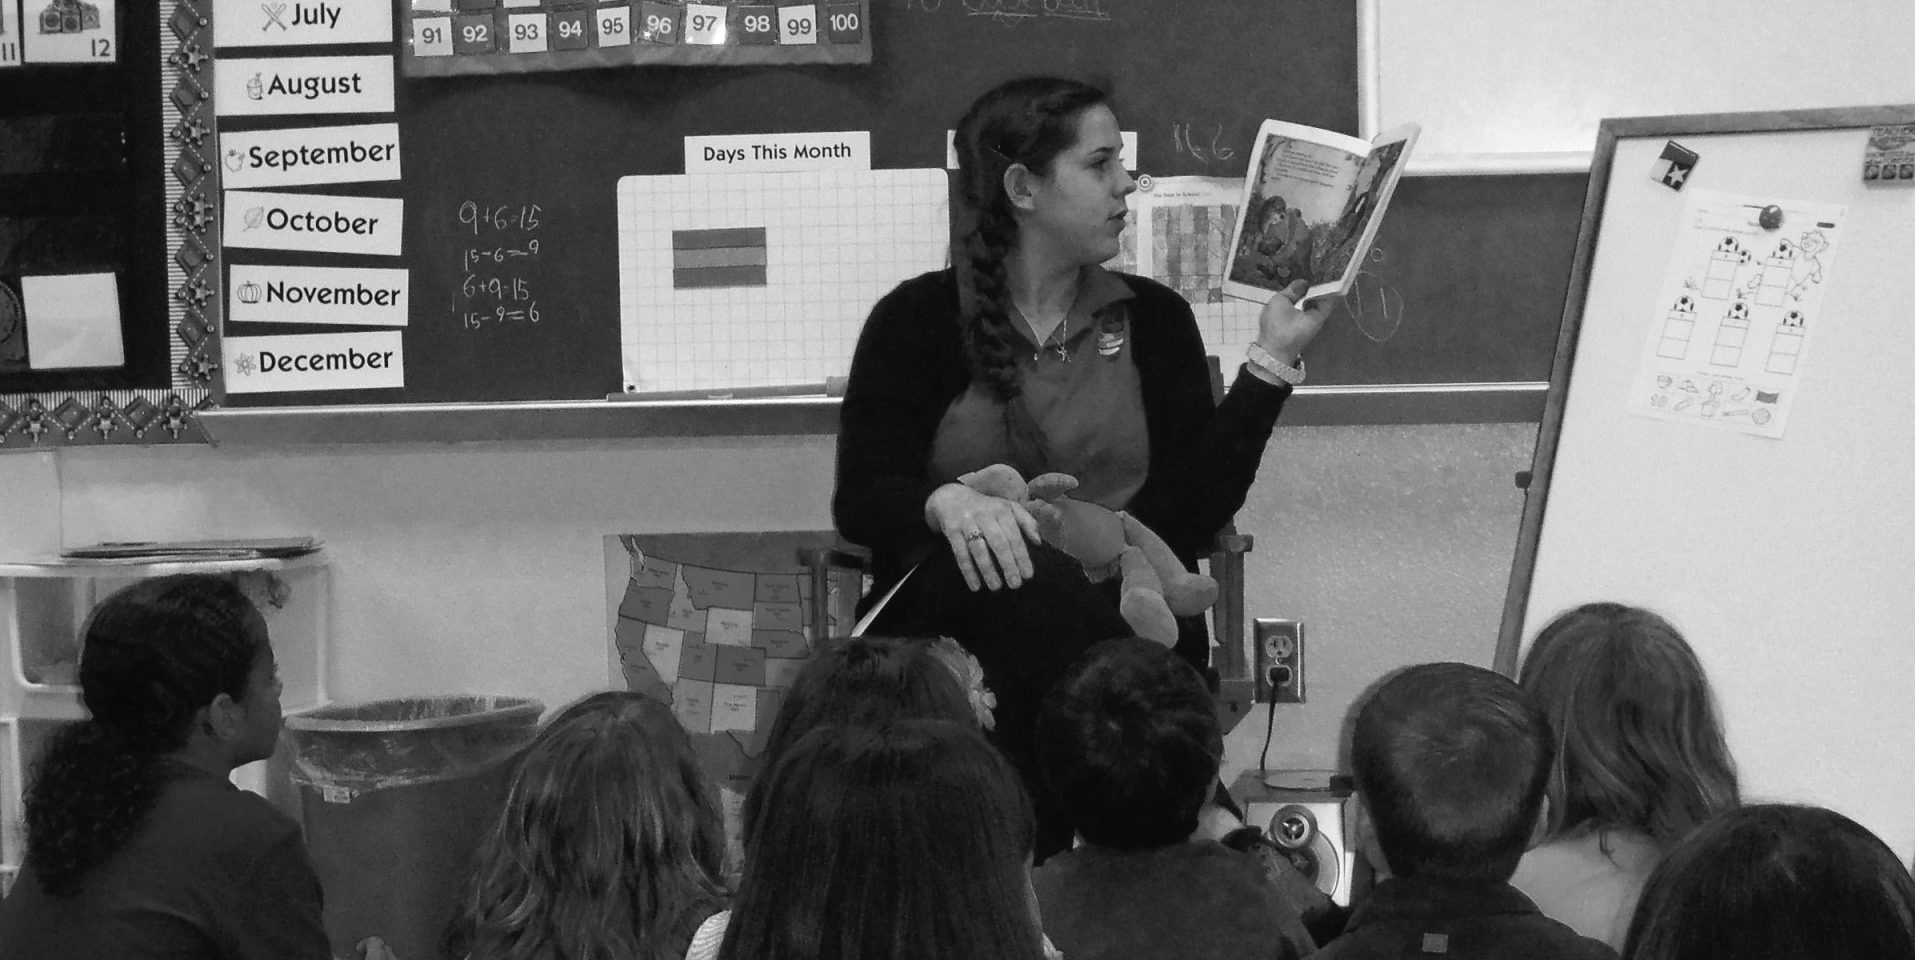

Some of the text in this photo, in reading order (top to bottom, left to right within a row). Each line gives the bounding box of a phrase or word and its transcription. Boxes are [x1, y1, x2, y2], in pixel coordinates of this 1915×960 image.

[291, 3, 342, 28] July
[421, 13, 859, 44] 91 92 93 94 95 96 97 98 99 100
[2, 43, 15, 60] 11
[91, 38, 110, 57] 12
[267, 73, 362, 99] August
[249, 142, 395, 171] September
[703, 142, 851, 164] Days This Month
[266, 208, 379, 235] October
[266, 281, 401, 306] November
[259, 349, 393, 372] December
